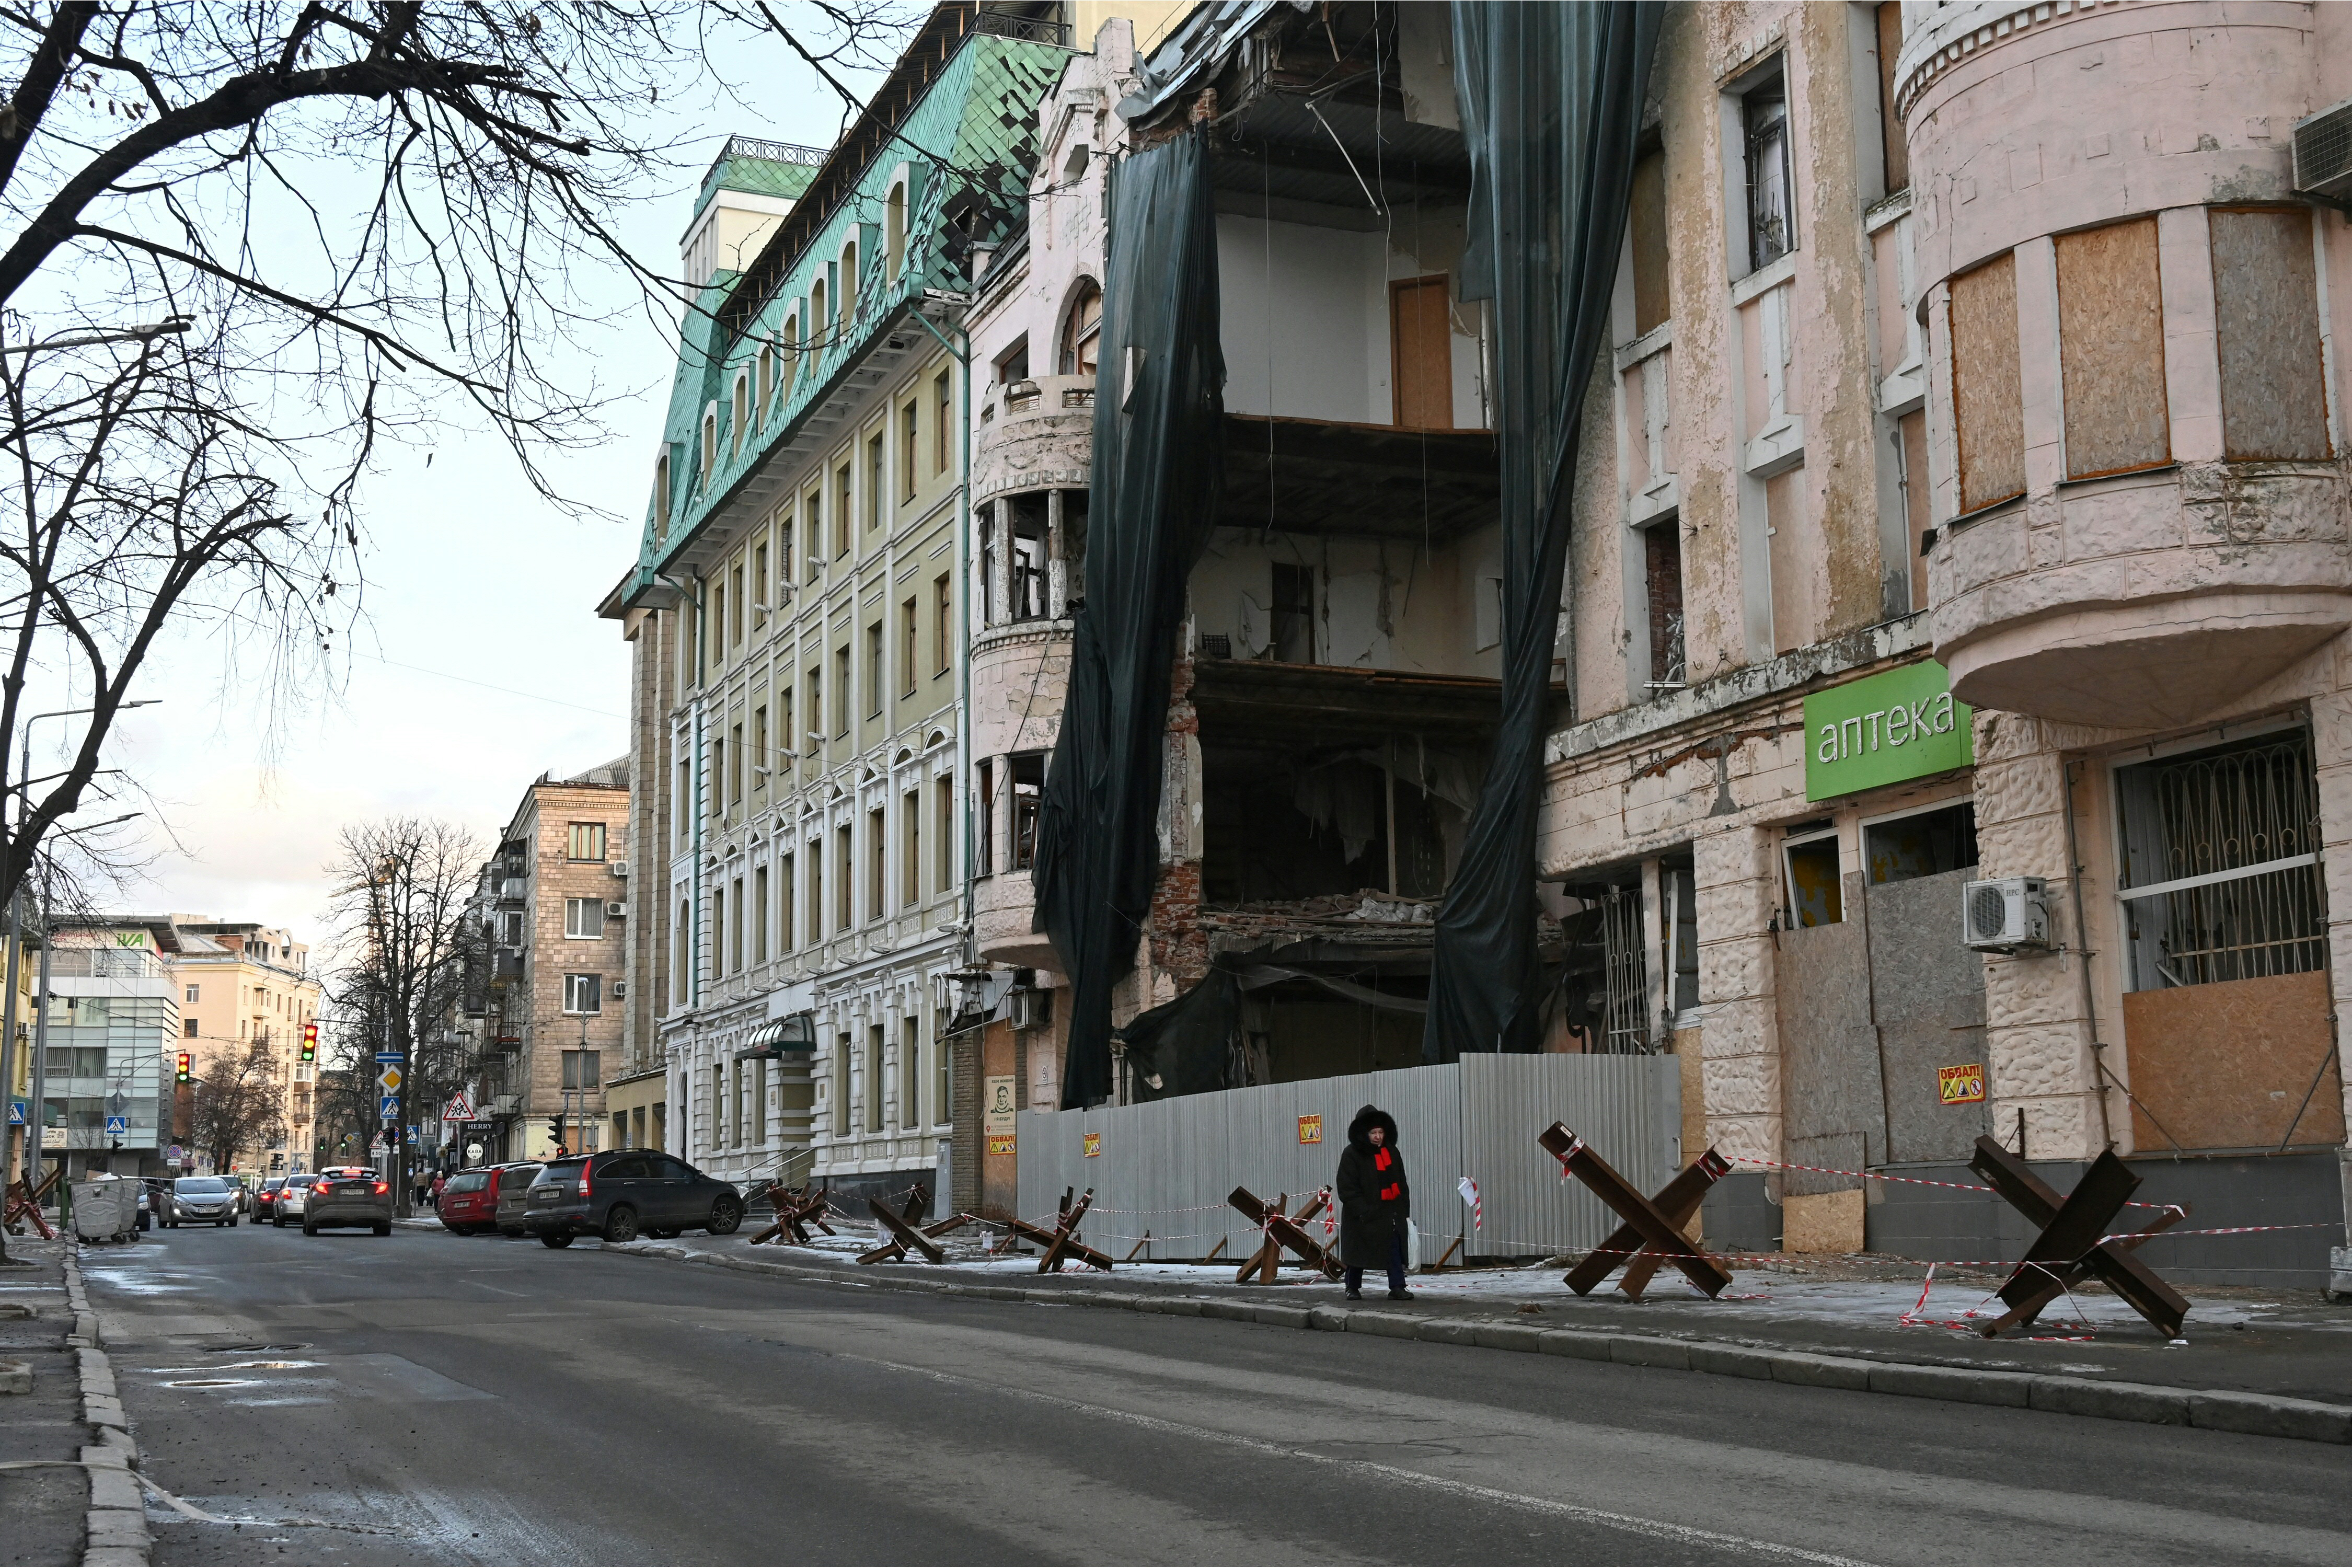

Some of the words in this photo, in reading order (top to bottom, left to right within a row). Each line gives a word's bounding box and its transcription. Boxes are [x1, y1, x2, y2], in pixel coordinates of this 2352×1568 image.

[1818, 692, 1955, 763] аптека
[1941, 1066, 1980, 1080] ОБВАЛ!
[1300, 1115, 1319, 1125] ОБВАЛ!
[1085, 1133, 1099, 1142] ОБВАЛ!
